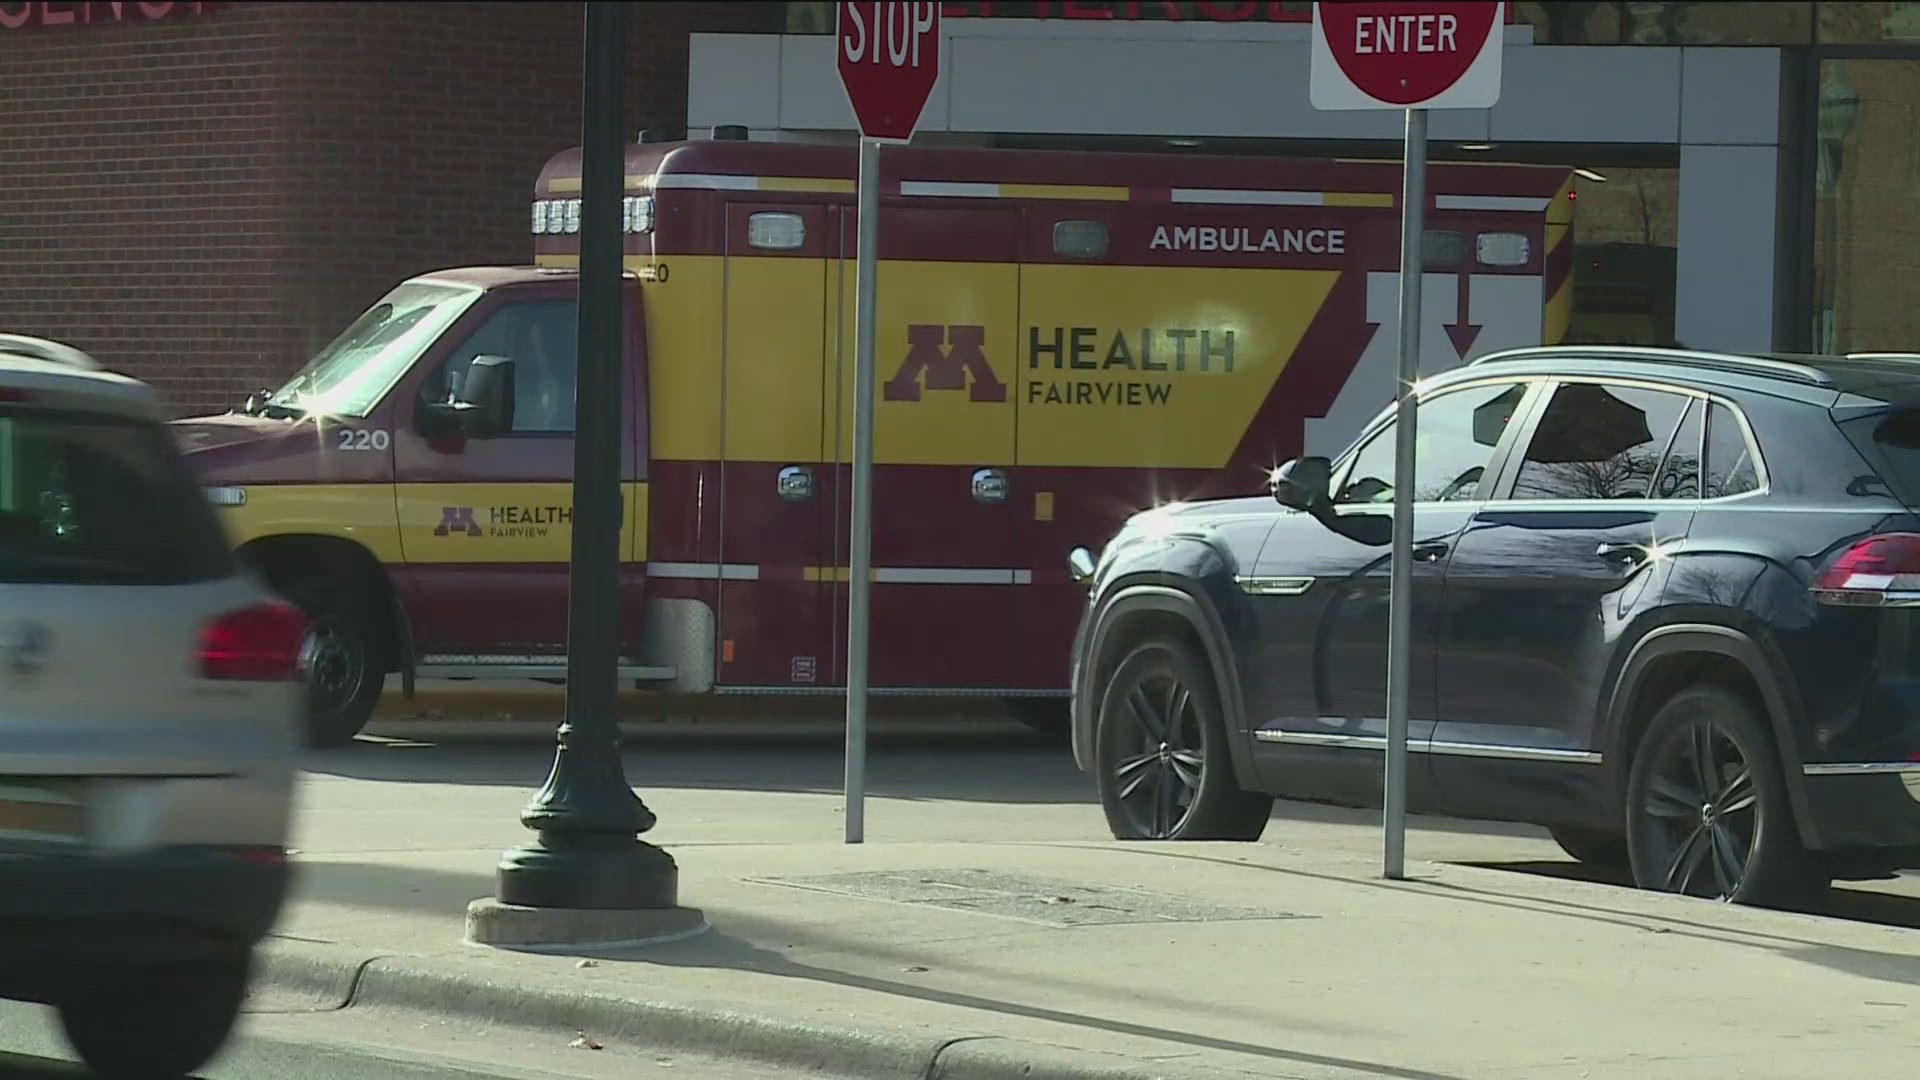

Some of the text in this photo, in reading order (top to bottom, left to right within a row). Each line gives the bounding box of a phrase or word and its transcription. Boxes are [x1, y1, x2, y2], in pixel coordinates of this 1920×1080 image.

[844, 2, 933, 67] STOP
[1355, 14, 1457, 54] ENTER
[1150, 226, 1344, 254] AMBULANCE
[1029, 327, 1235, 373] HEALTH
[1028, 381, 1173, 406] FAIRVIEW
[339, 429, 390, 451] 220
[490, 507, 573, 524] HEALTH
[490, 527, 548, 538] FAIRVIEW
